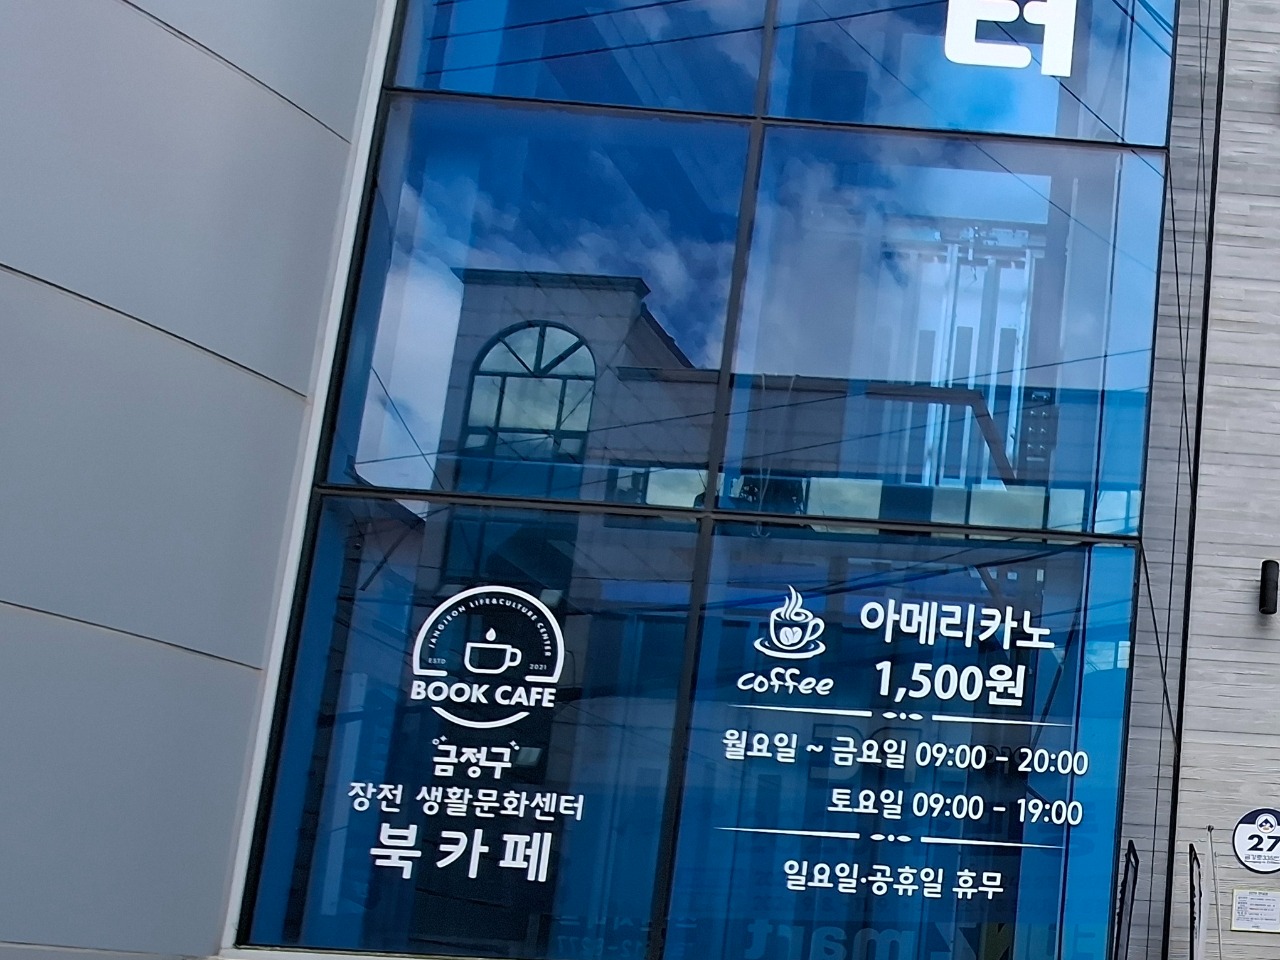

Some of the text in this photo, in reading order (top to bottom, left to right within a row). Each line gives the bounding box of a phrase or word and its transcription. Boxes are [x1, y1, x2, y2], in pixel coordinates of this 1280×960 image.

[860, 598, 1056, 650] 아메리카노
[529, 663, 547, 671] 2021
[736, 666, 834, 696] coffee
[874, 660, 1027, 707] 1,500원
[410, 680, 557, 708] BOOK CAFE
[432, 744, 513, 779] 금정구
[722, 728, 798, 763] 월요일
[831, 736, 907, 770] 금요일
[915, 741, 987, 771] 09:00
[1017, 748, 1089, 776] 20:00
[347, 782, 585, 822] 장전 생활문화센터
[827, 788, 904, 820] 토요일
[912, 792, 985, 820] 09:00
[1016, 798, 1084, 826] 19:00
[952, 868, 1004, 900] 휴무
